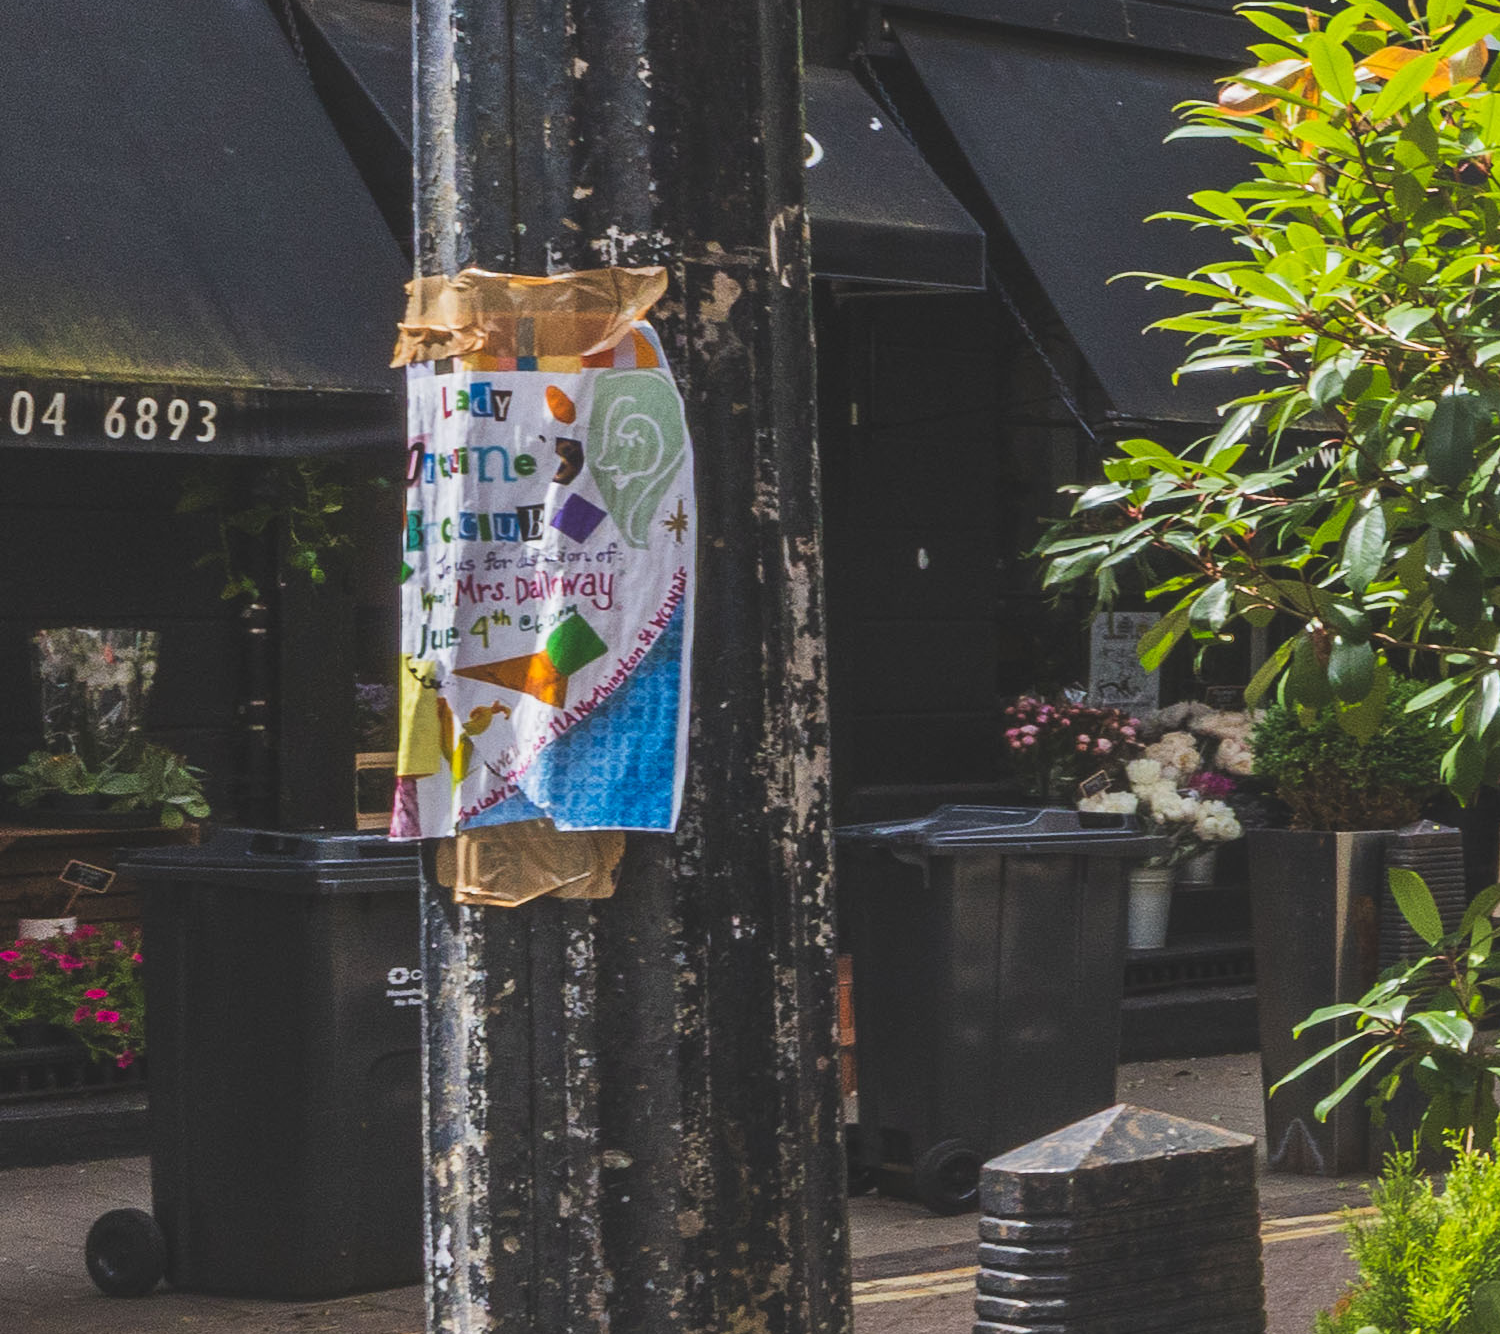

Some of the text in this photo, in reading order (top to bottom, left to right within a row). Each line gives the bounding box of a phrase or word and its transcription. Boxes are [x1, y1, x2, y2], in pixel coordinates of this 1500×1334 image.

[10, 390, 217, 442] 04 6893
[441, 382, 512, 420] Lady
[456, 573, 510, 607] Mrs.
[417, 624, 460, 659] Jue
